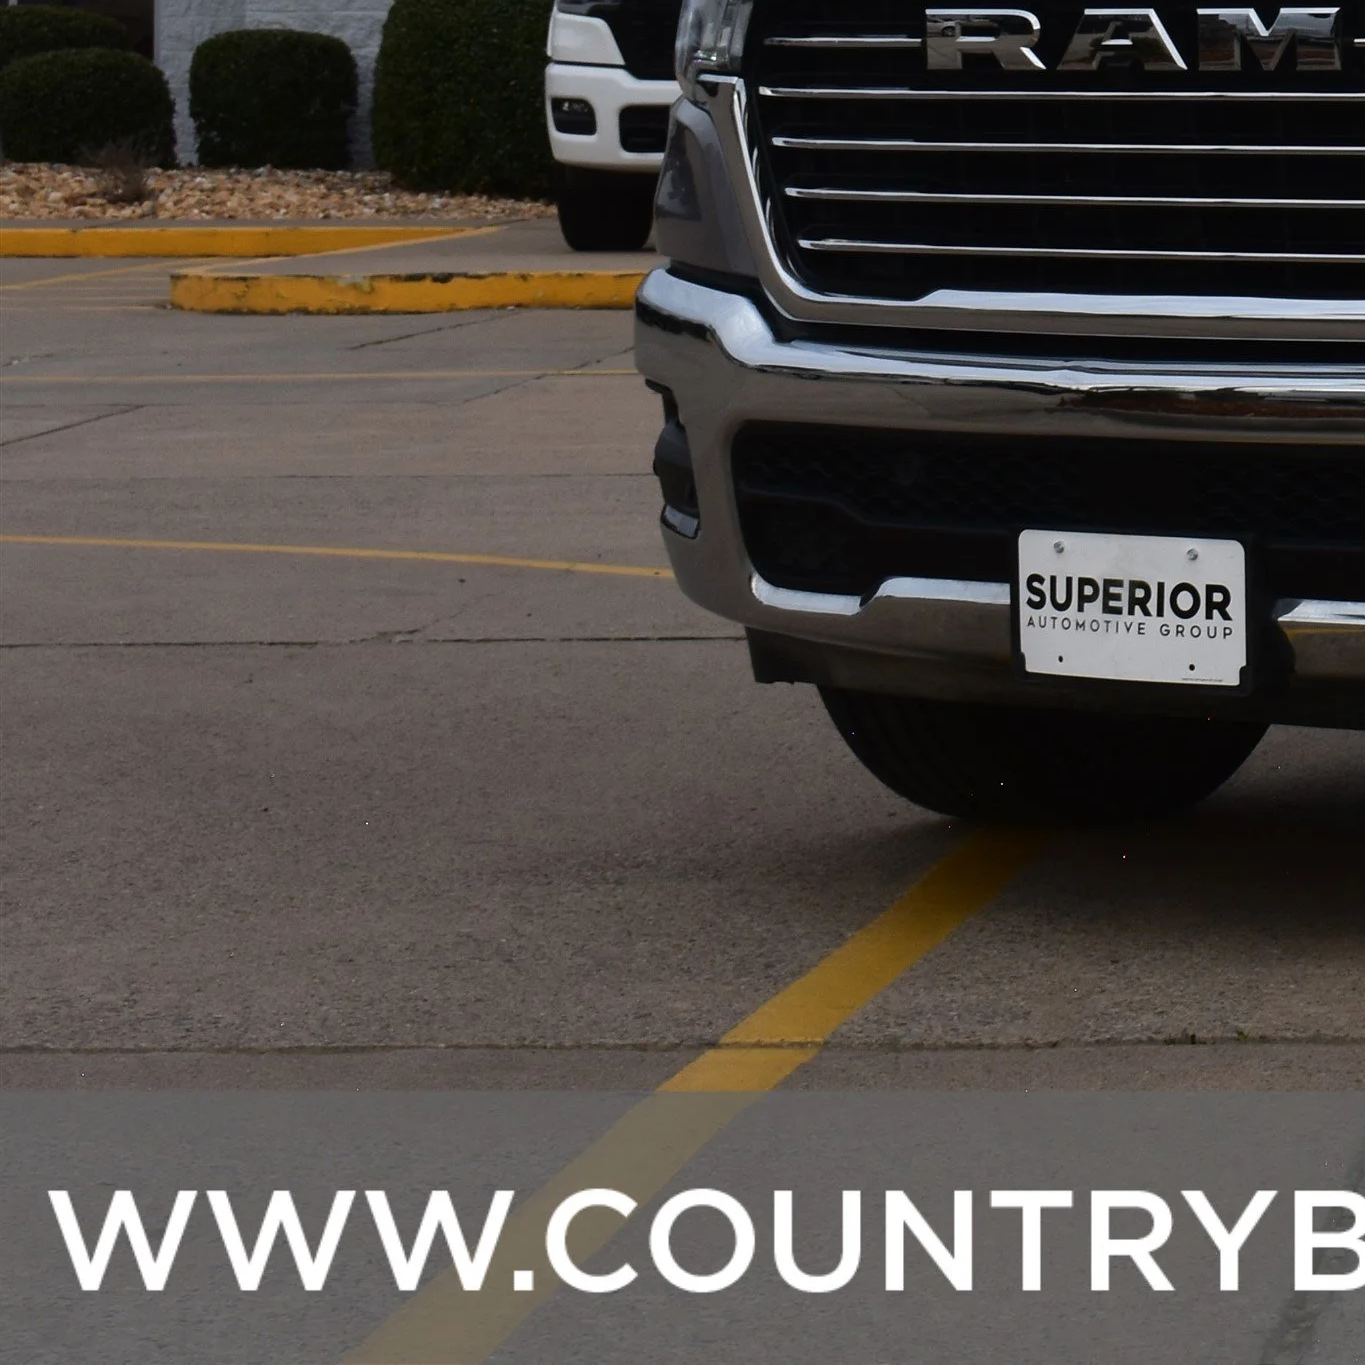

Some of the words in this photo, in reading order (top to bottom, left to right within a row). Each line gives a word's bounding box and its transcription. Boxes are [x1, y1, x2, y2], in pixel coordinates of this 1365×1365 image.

[924, 6, 1343, 72] RAM
[1026, 573, 1233, 621] SUPERIOR
[1027, 616, 1146, 635] AUTOMOTIVE
[1160, 623, 1233, 640] GROUP
